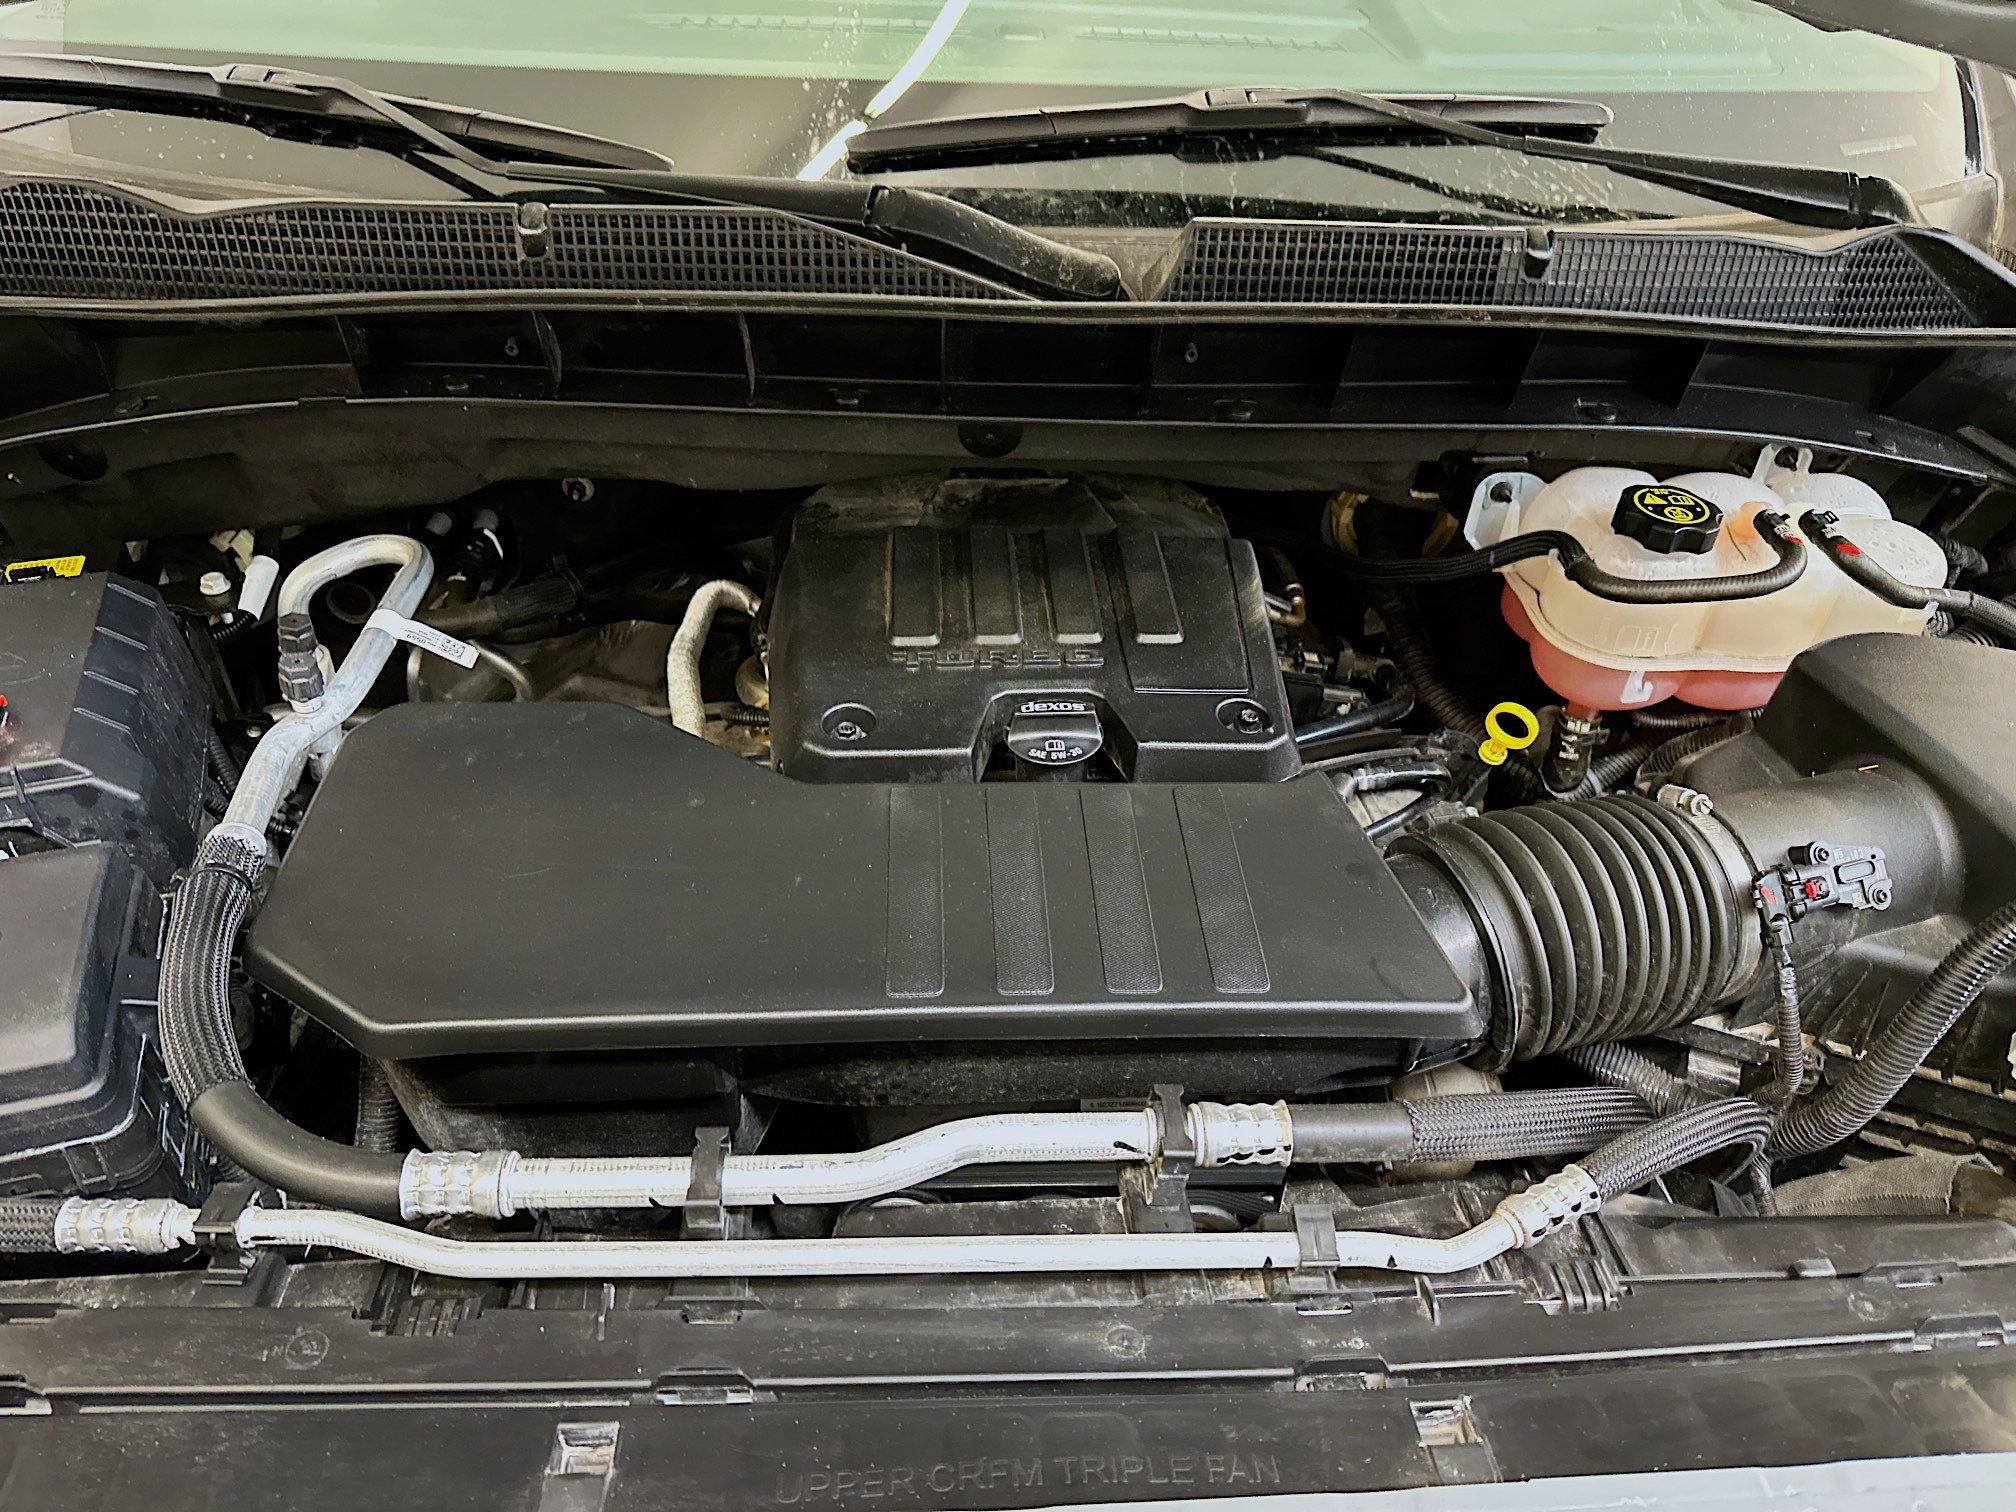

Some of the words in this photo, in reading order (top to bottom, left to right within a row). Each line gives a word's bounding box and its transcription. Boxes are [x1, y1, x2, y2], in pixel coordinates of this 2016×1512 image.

[1020, 701, 1086, 713] dexos
[1028, 748, 1048, 760] SAE
[1050, 746, 1083, 760] 5W-30
[775, 1467, 917, 1503] UPPER
[926, 1457, 1044, 1493] CRFM
[1053, 1454, 1196, 1485] TRIPLE
[1206, 1453, 1282, 1484] FAN
